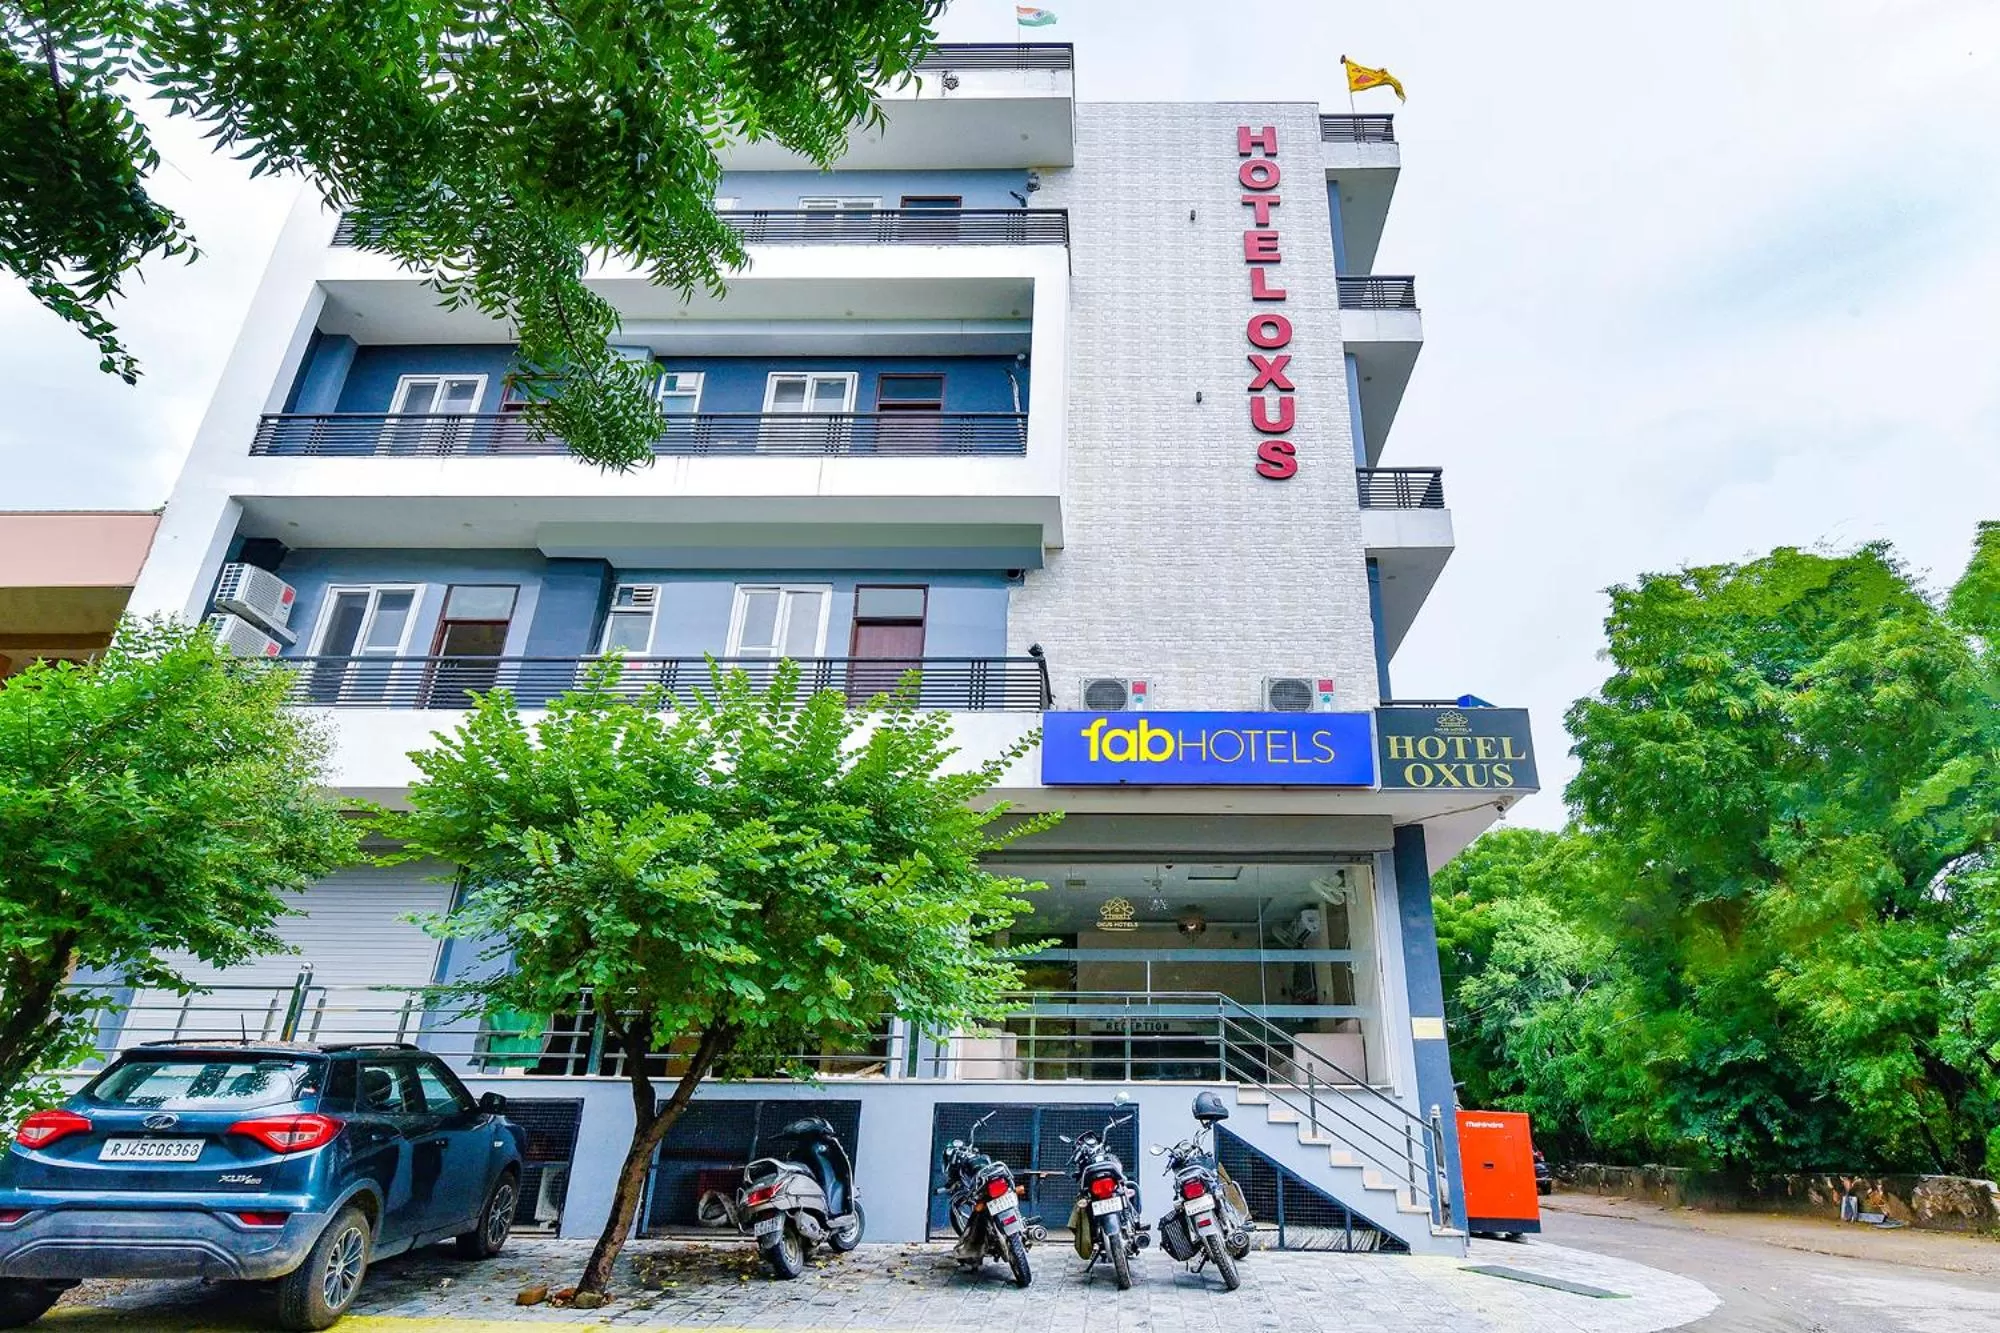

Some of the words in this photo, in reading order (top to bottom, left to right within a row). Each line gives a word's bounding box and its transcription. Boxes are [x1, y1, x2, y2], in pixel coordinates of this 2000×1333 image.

[1237, 126, 1287, 301] HOTEL
[1247, 314, 1298, 480] OXUS
[1386, 735, 1526, 760] HOTEL
[1404, 763, 1515, 788] OXUS
[1106, 1021, 1169, 1031] RECEPTION
